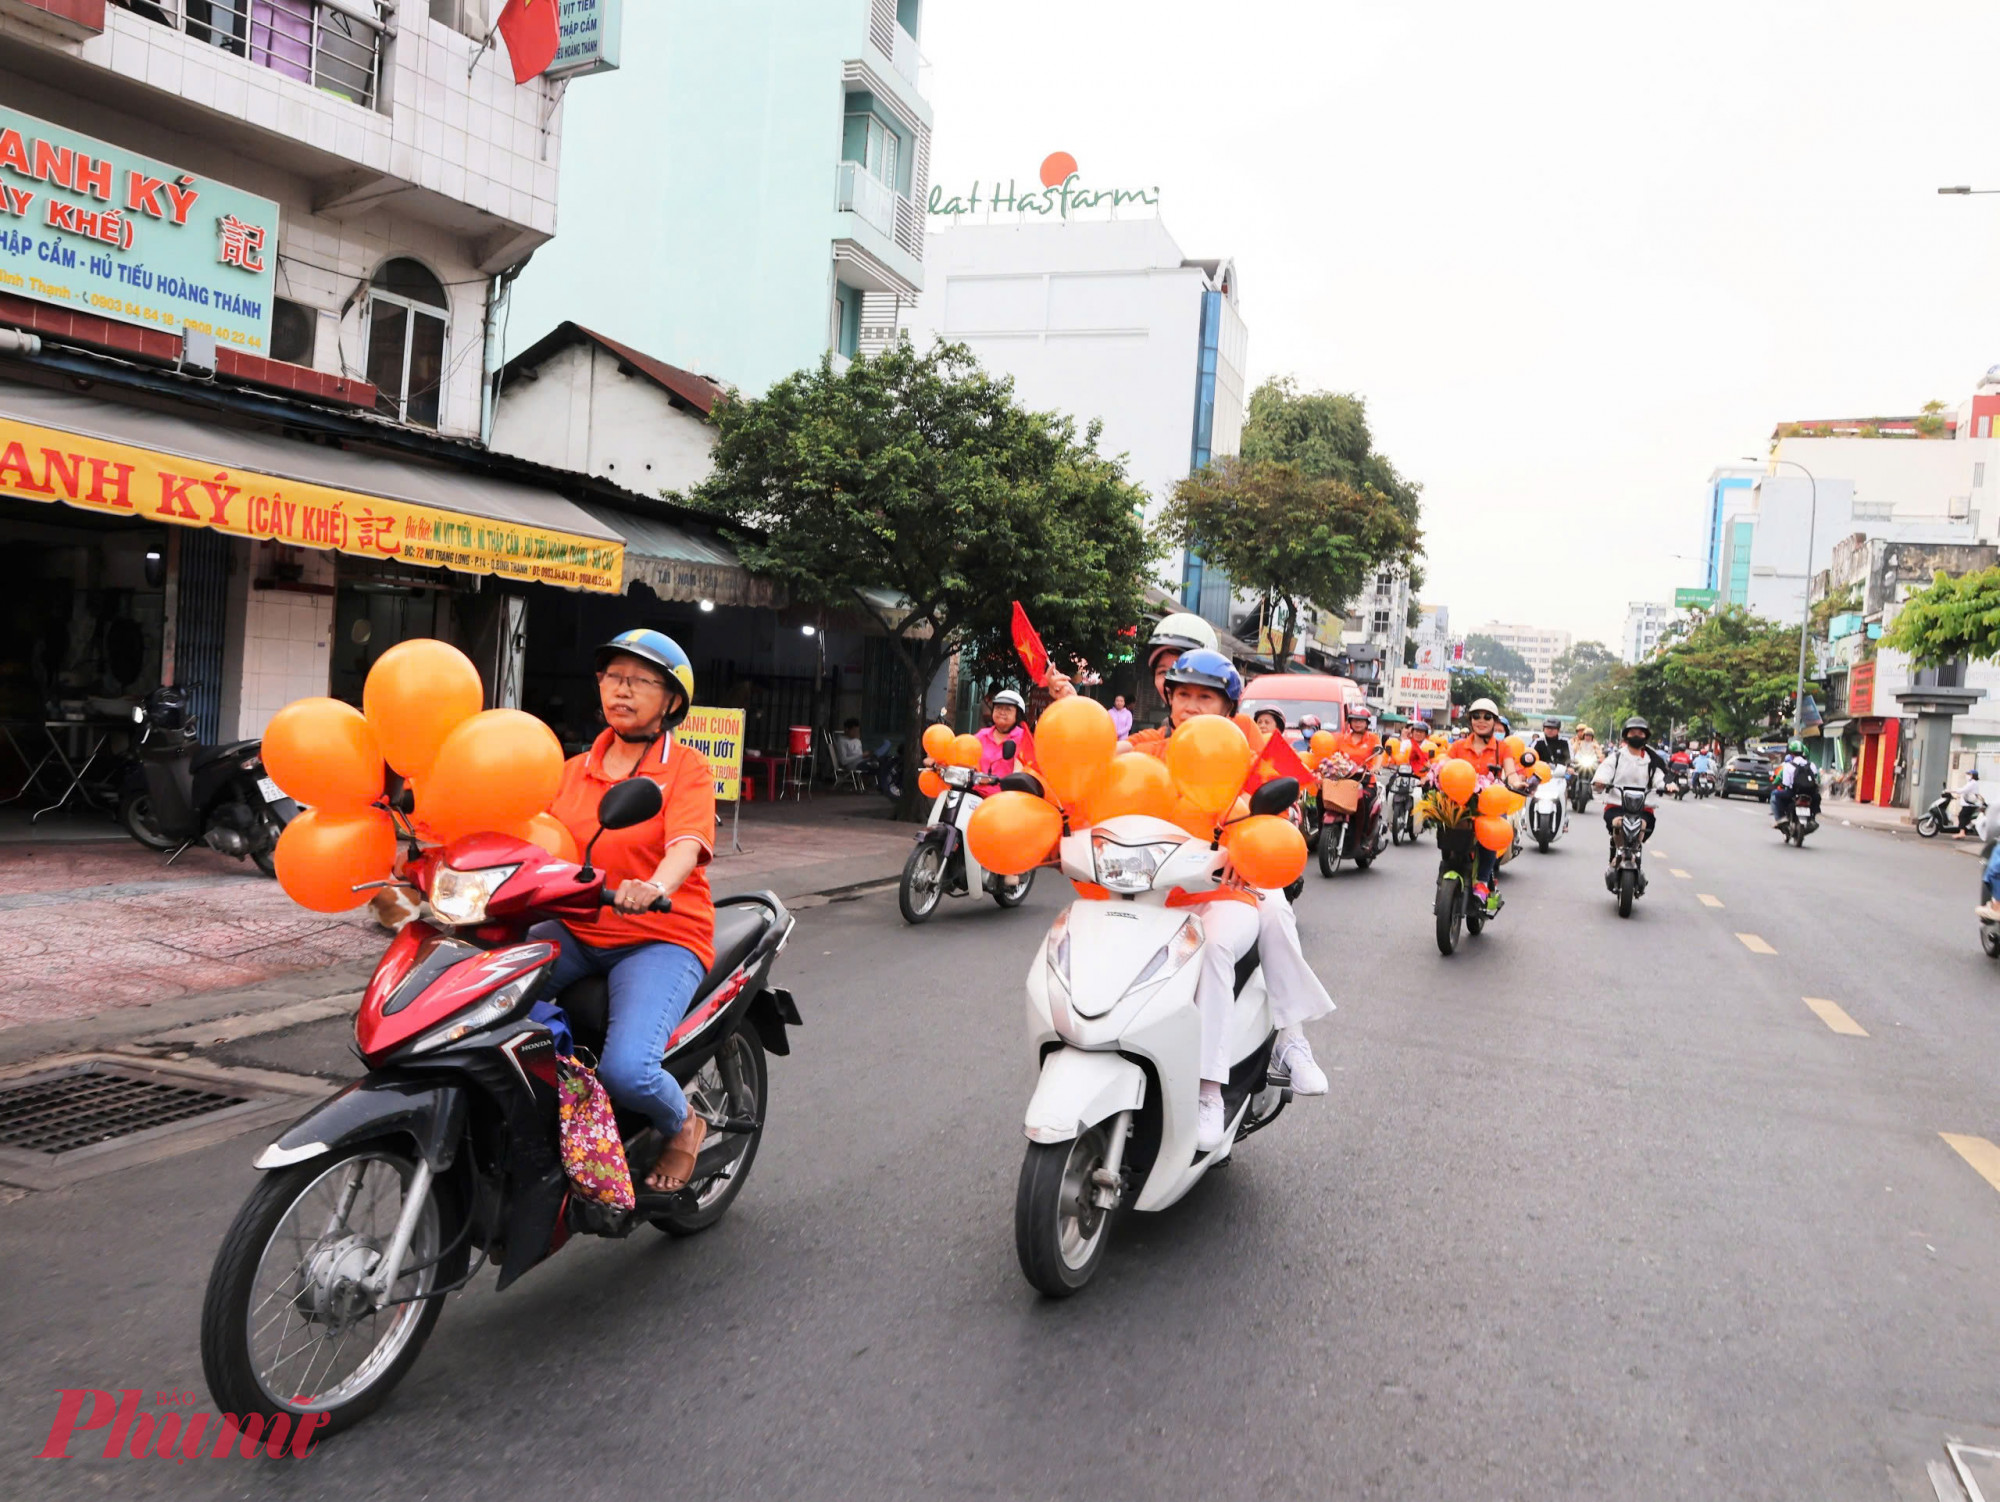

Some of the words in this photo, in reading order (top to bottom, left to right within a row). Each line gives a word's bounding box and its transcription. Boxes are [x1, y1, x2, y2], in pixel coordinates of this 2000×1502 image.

[563, 2, 576, 18] VỊT
[126, 175, 200, 226] KÝ
[989, 173, 1160, 219] Hasfarm
[46, 199, 134, 251] KHẾ)
[217, 214, 267, 273] 記
[90, 253, 112, 279] HỦ
[117, 263, 153, 290] TIẾU
[157, 275, 209, 306] HOÀNG
[213, 289, 262, 320] THÁNH
[90, 293, 122, 313] 0903
[125, 301, 141, 318] 64
[231, 330, 246, 345] 22
[247, 334, 262, 349] 44
[0, 440, 136, 508] ANH
[156, 471, 242, 526] KÝ
[247, 492, 297, 537] (CÂY
[302, 500, 349, 550] KHẾ)
[353, 507, 401, 555] 記
[416, 547, 425, 559] 72
[435, 550, 454, 563] TRANG
[455, 552, 471, 566] LONG
[1412, 671, 1430, 691] TIẾU
[710, 712, 740, 737] CUỐN
[713, 738, 736, 759] ƯỚT
[521, 1039, 553, 1052] HONDA
